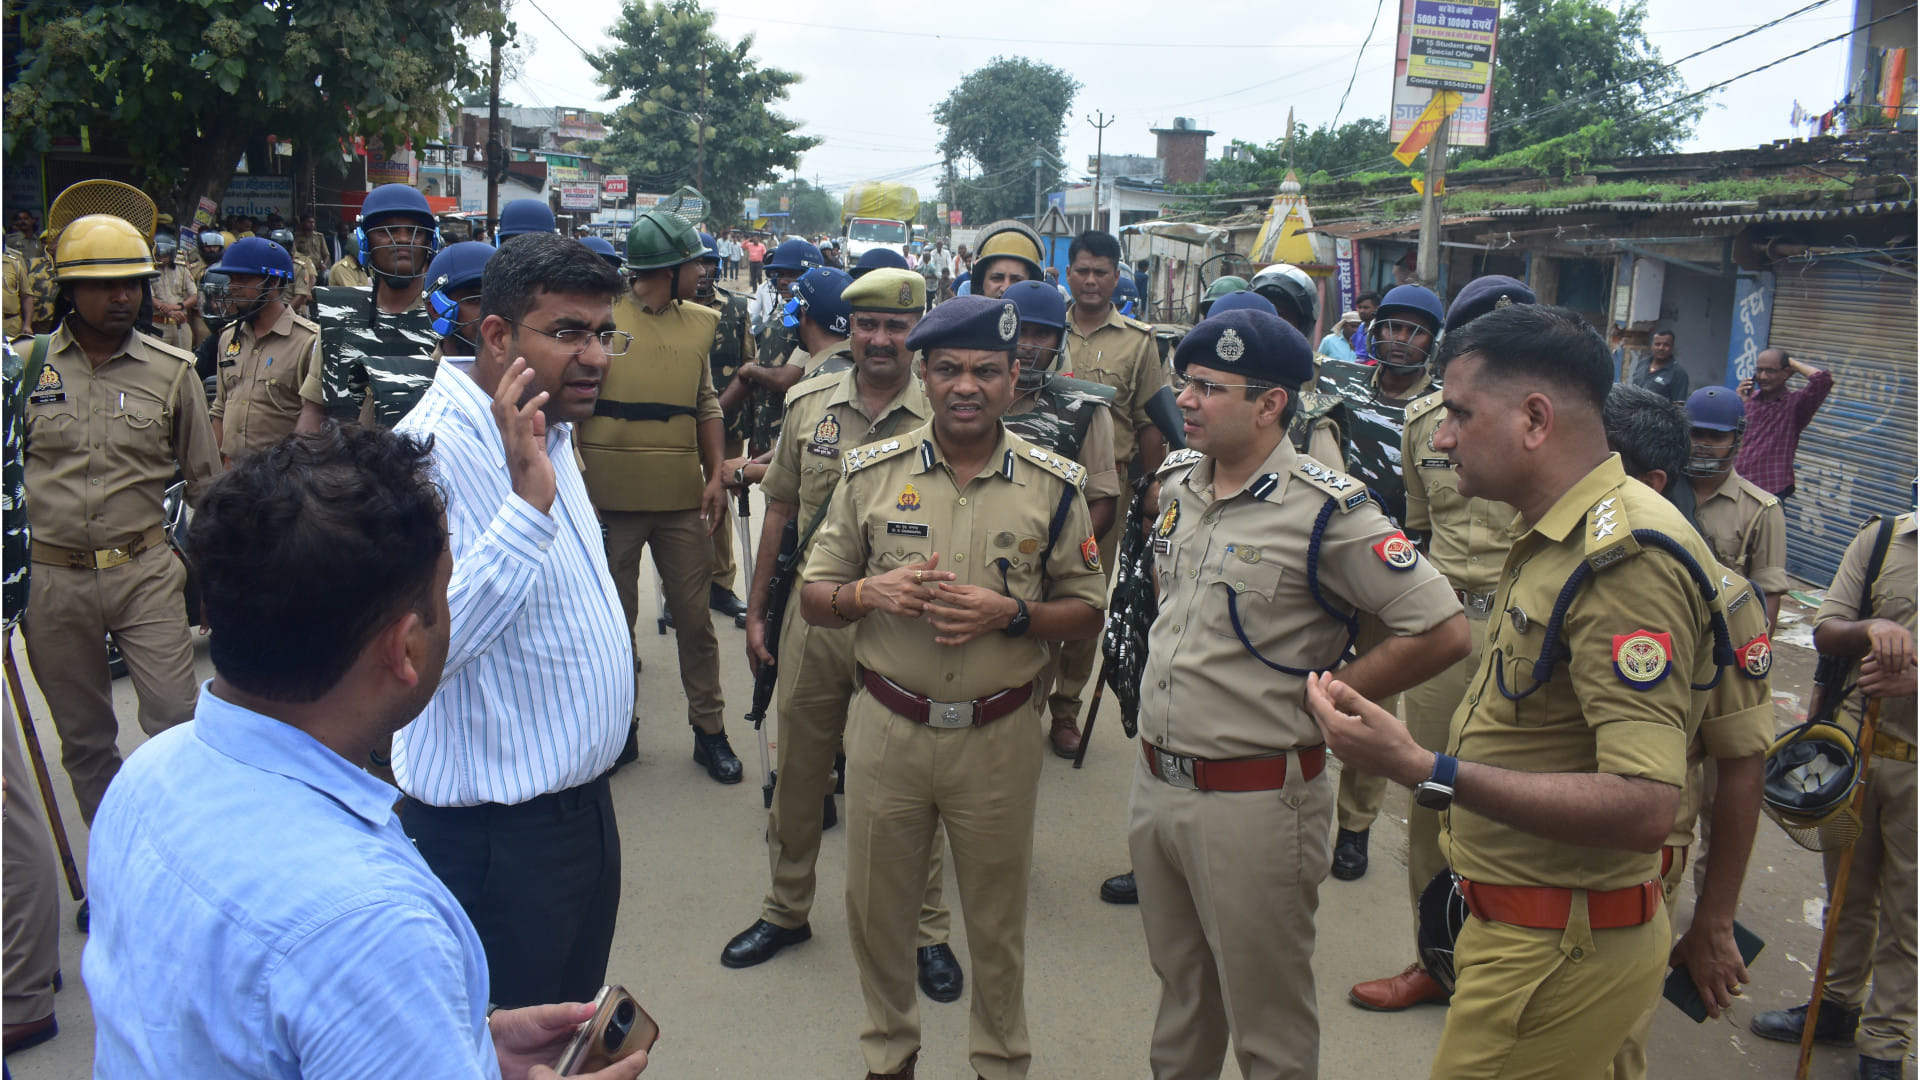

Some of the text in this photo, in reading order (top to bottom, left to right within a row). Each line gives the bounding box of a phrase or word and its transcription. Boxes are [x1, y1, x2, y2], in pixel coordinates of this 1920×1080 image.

[1416, 13, 1437, 24] 5000
[1438, 13, 1446, 25] से
[1447, 17, 1471, 29] 10000
[1435, 40, 1465, 49] Student
[1426, 47, 1475, 59] Special Offer
[1409, 77, 1439, 86] Contact
